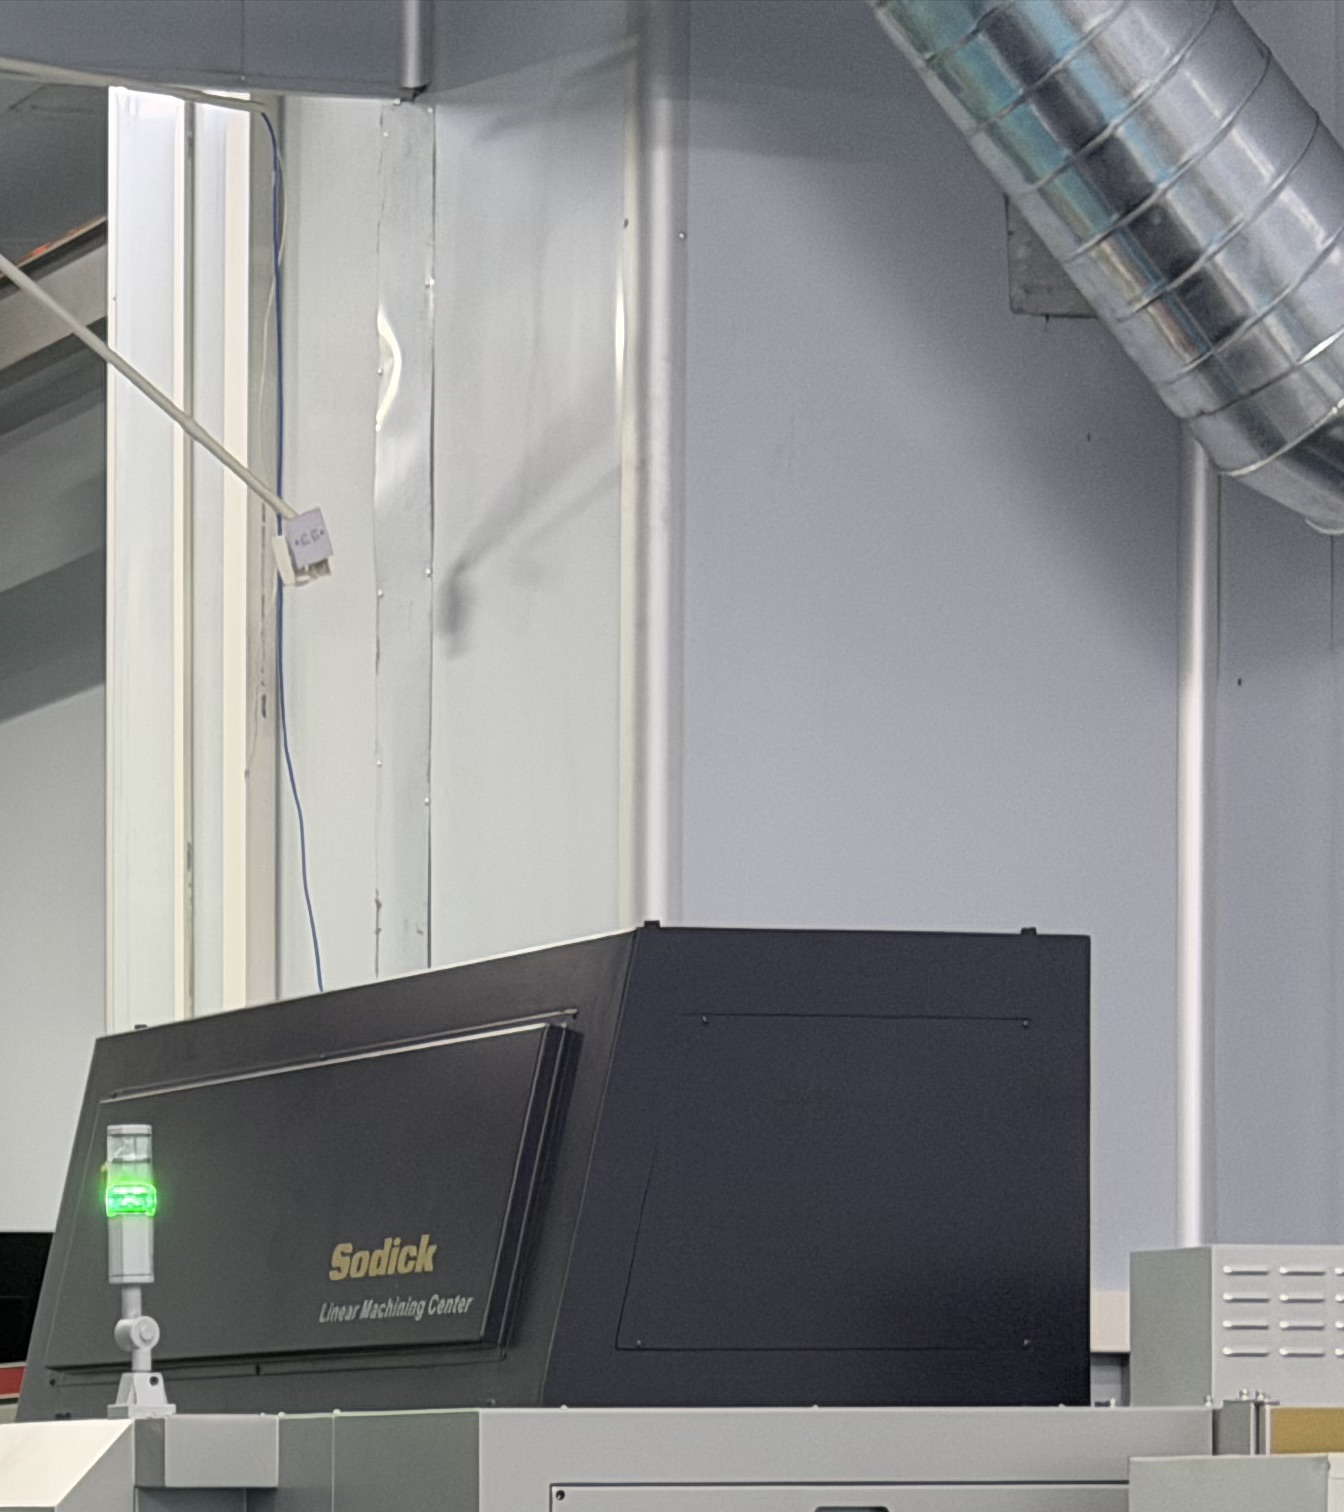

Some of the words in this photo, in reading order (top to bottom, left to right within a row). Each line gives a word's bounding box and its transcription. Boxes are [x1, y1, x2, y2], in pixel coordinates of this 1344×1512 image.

[328, 1233, 438, 1282] Sodick
[319, 1301, 360, 1324] Linear
[359, 1296, 426, 1322] Machining
[428, 1293, 473, 1316] Center
